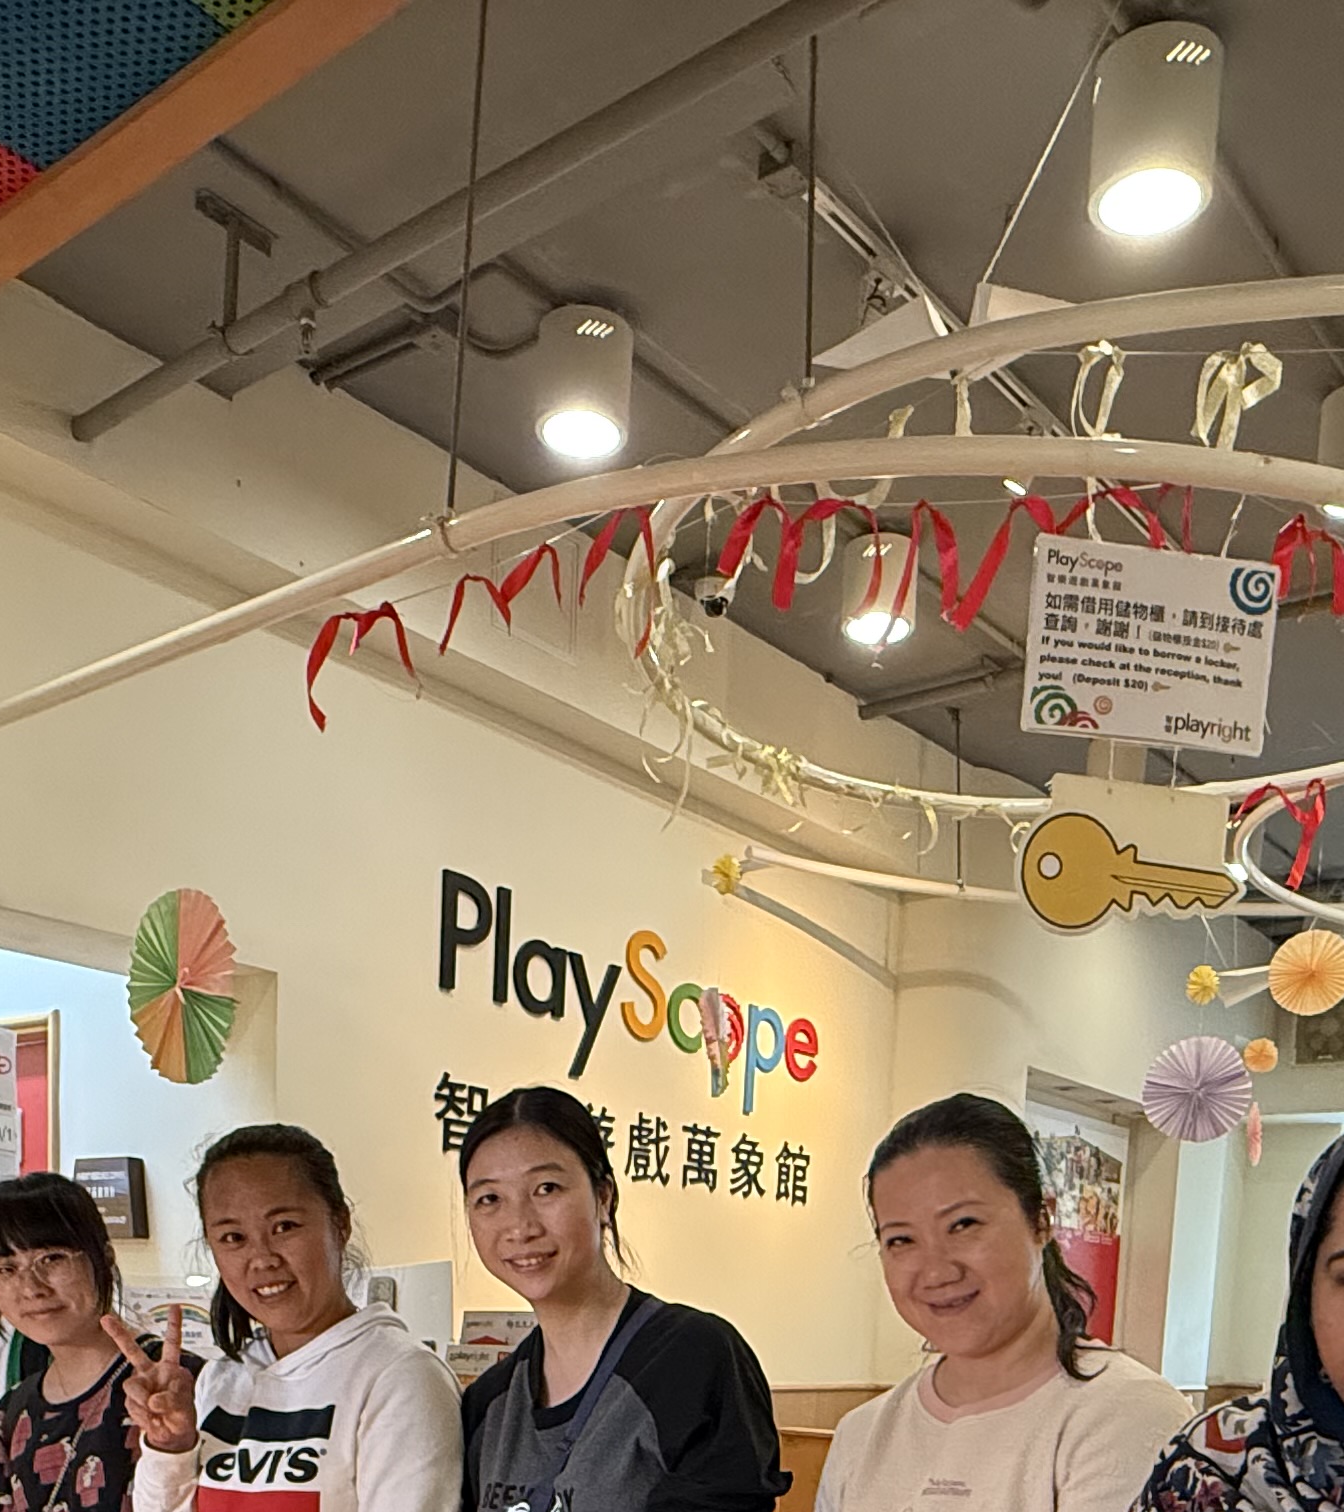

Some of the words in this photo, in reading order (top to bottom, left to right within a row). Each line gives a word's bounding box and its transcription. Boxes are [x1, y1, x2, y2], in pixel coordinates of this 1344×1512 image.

[1047, 548, 1124, 577] PlayScope
[1041, 635, 1051, 645] If
[1053, 638, 1074, 649] you
[1077, 640, 1112, 652] would
[1114, 643, 1136, 655] like
[1138, 647, 1150, 657] to
[1153, 648, 1192, 662] borrow
[1195, 656, 1202, 664] a
[1204, 655, 1240, 672] locker,
[1038, 671, 1063, 682] you!
[1072, 672, 1121, 688] (Deposit
[1123, 678, 1149, 693] $20)
[1039, 653, 1079, 665] please
[1080, 657, 1116, 669] check
[1118, 662, 1131, 671] at
[1133, 662, 1153, 674] the
[1154, 667, 1210, 684] reception,
[1212, 674, 1243, 689] thank
[1173, 712, 1252, 744] playright
